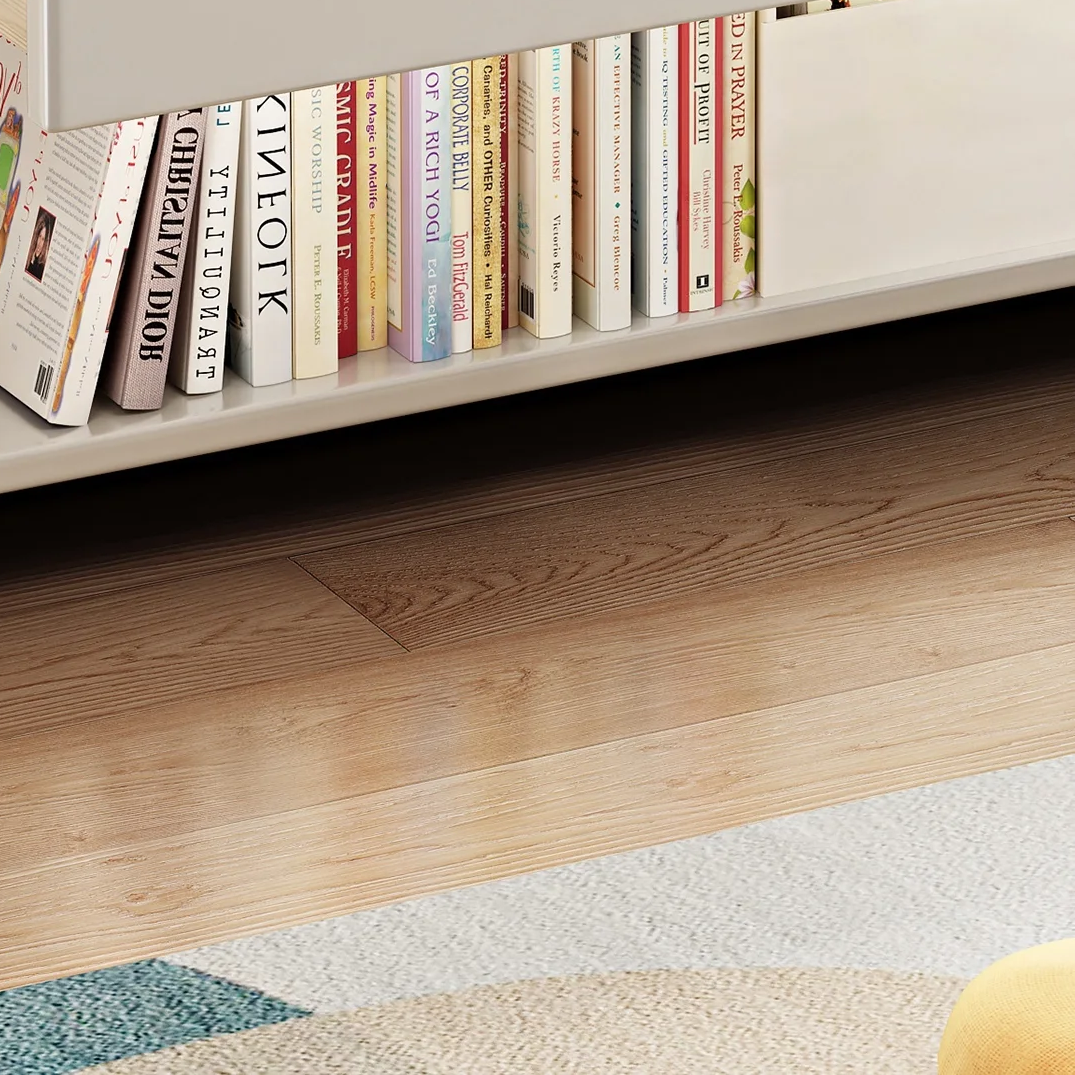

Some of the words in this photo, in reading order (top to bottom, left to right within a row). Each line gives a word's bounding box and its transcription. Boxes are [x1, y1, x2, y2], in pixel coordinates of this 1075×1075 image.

[662, 60, 669, 73] IQ
[698, 54, 710, 74] OF
[731, 43, 742, 60] IN
[425, 72, 439, 100] OF
[483, 65, 492, 119] Canaries,
[552, 76, 560, 92] OF
[613, 65, 621, 131] EFFECTIVE
[731, 66, 745, 140] PRAYER
[366, 104, 376, 142] Magic
[426, 110, 439, 123] A
[452, 66, 469, 148] CORPORATE
[552, 96, 560, 136] KRAZY
[694, 83, 710, 144] PROFIT
[369, 147, 376, 158] in
[426, 131, 439, 181] RICH
[484, 125, 493, 146] and
[311, 125, 322, 213] WORSHIP
[453, 152, 469, 190] BELLY
[484, 150, 493, 191] OTHER
[552, 141, 560, 182] HORSE
[613, 135, 621, 193] MANAGER
[734, 164, 743, 191] Peter
[369, 164, 377, 209] Midlife
[703, 169, 712, 214] Christine
[426, 189, 440, 242] YOGI
[484, 195, 492, 257] Curiosities
[612, 216, 621, 242] Greg
[691, 209, 701, 232] Sykes
[701, 216, 712, 249] Harvey
[453, 231, 468, 259] Tom
[553, 215, 561, 258] Victorio
[733, 210, 743, 263] Roussakis
[314, 245, 322, 276] PETER
[428, 259, 437, 278] Ed
[551, 262, 561, 292] Reyes
[613, 246, 621, 291] Blencoe
[453, 263, 468, 322] FitzGerald
[314, 293, 322, 345] ROUSSAKIS
[426, 285, 437, 345] Beckley
